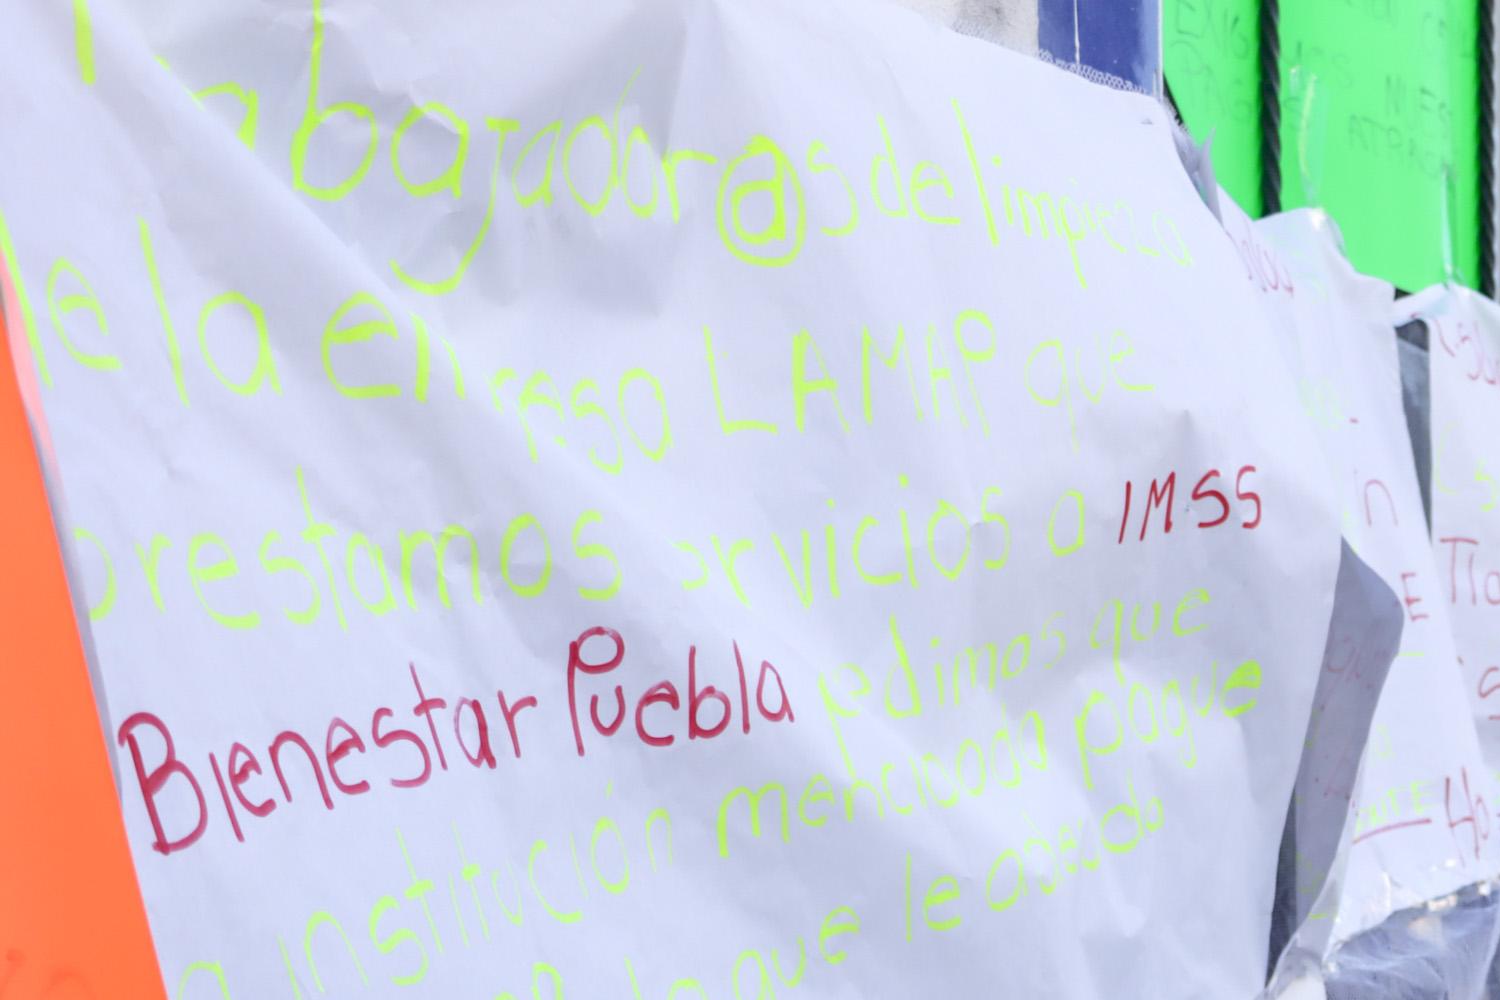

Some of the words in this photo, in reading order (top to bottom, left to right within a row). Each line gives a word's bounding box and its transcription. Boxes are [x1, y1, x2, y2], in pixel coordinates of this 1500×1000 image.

[870, 113, 962, 226] de
[135, 215, 283, 408] la
[703, 308, 992, 440] LAMAP
[1024, 328, 1156, 456] que
[1118, 465, 1262, 545] IMSS
[117, 660, 540, 856] Bienestar
[566, 626, 795, 757] Puebla
[905, 849, 963, 943] le
